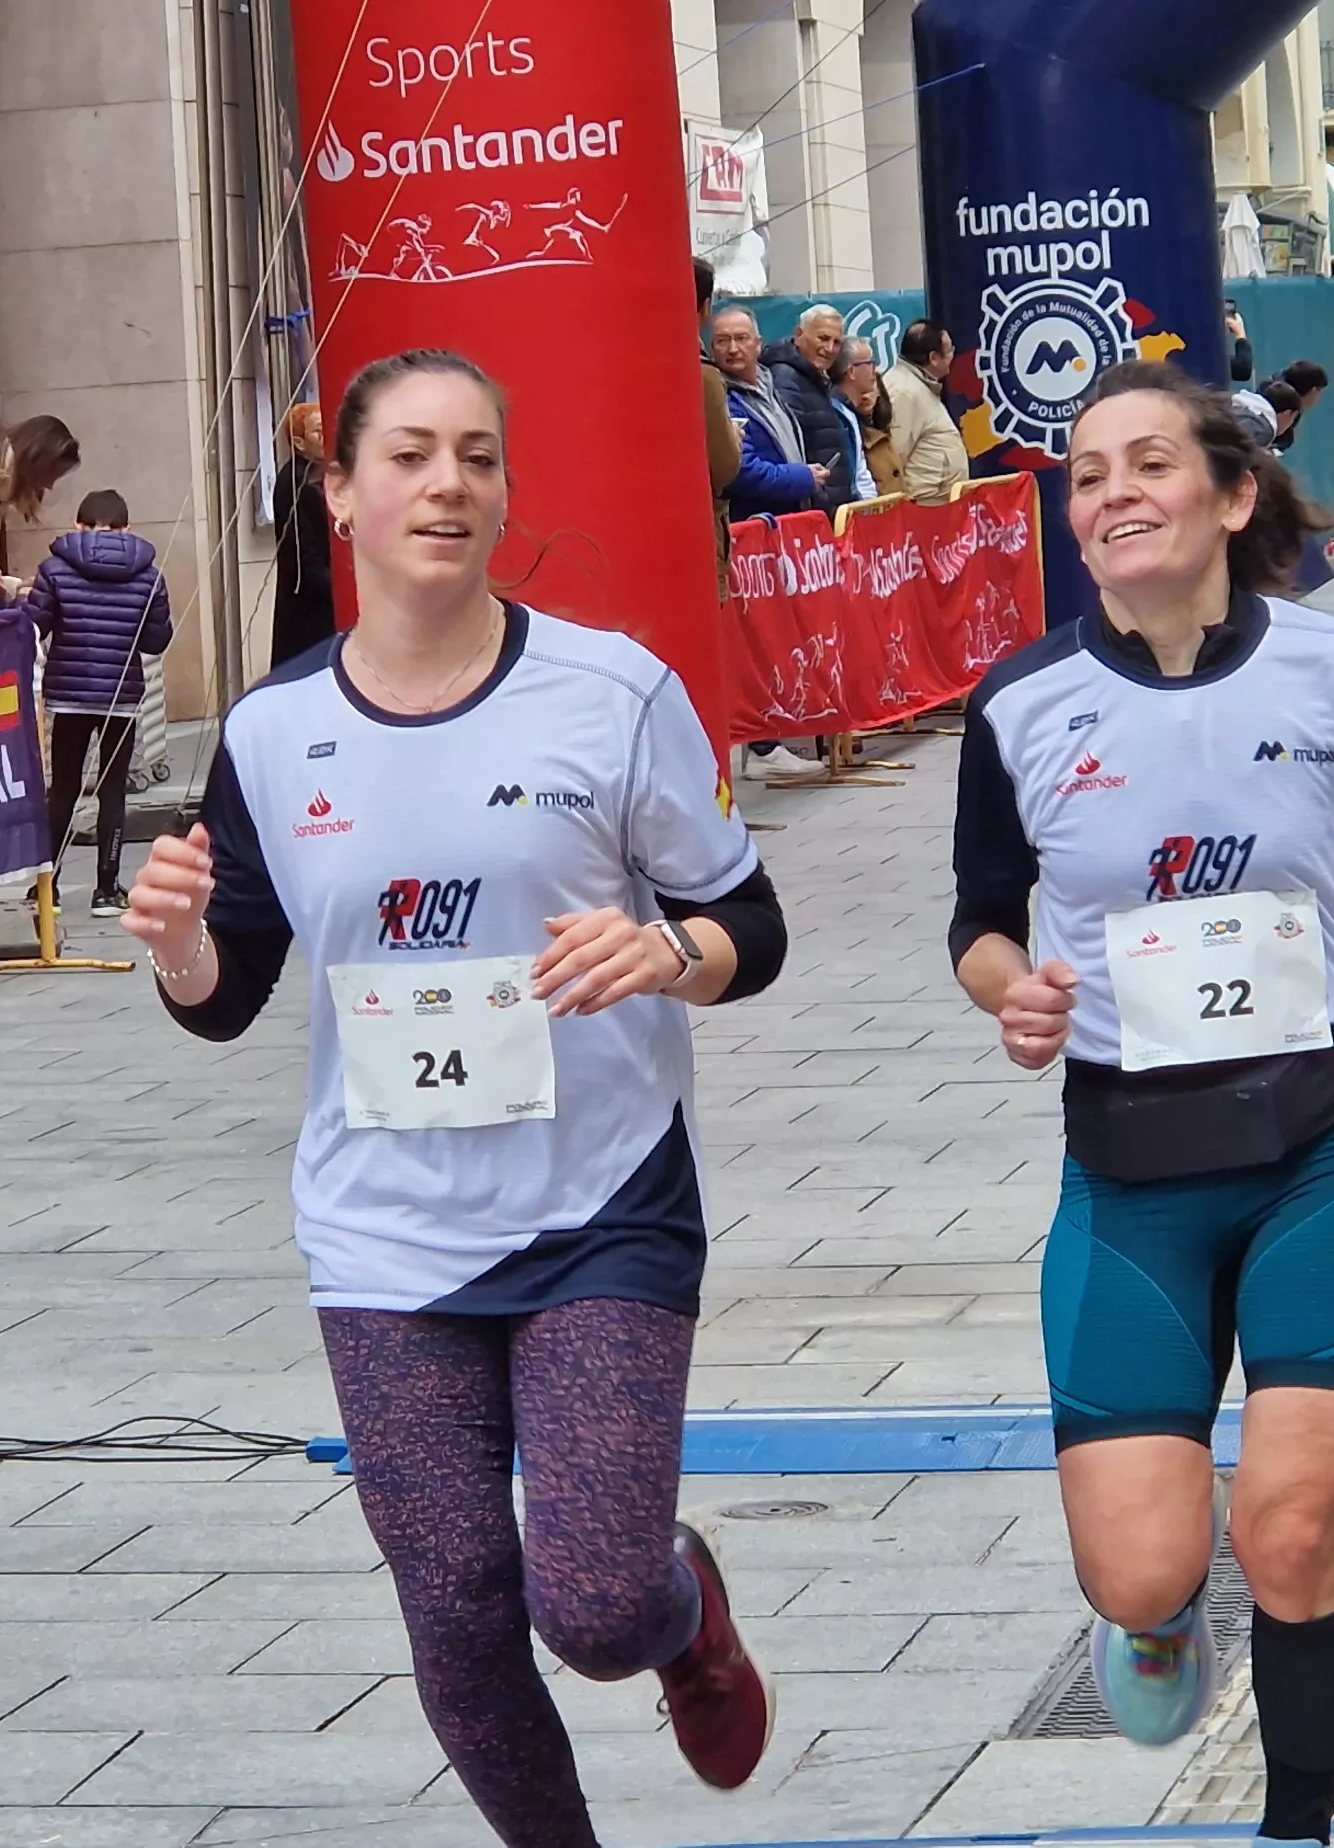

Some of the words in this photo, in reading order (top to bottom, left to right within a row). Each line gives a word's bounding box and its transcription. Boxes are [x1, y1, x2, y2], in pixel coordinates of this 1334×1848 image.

[366, 31, 536, 98] Sports
[361, 113, 623, 178] Santander
[955, 187, 1150, 237] fundación
[986, 229, 1112, 280] mupol
[1021, 309, 1035, 321] de
[1035, 304, 1047, 314] la
[535, 790, 595, 811] mupol
[291, 817, 356, 839] Santander
[1196, 978, 1255, 1020] 22
[411, 1048, 469, 1089] 24
